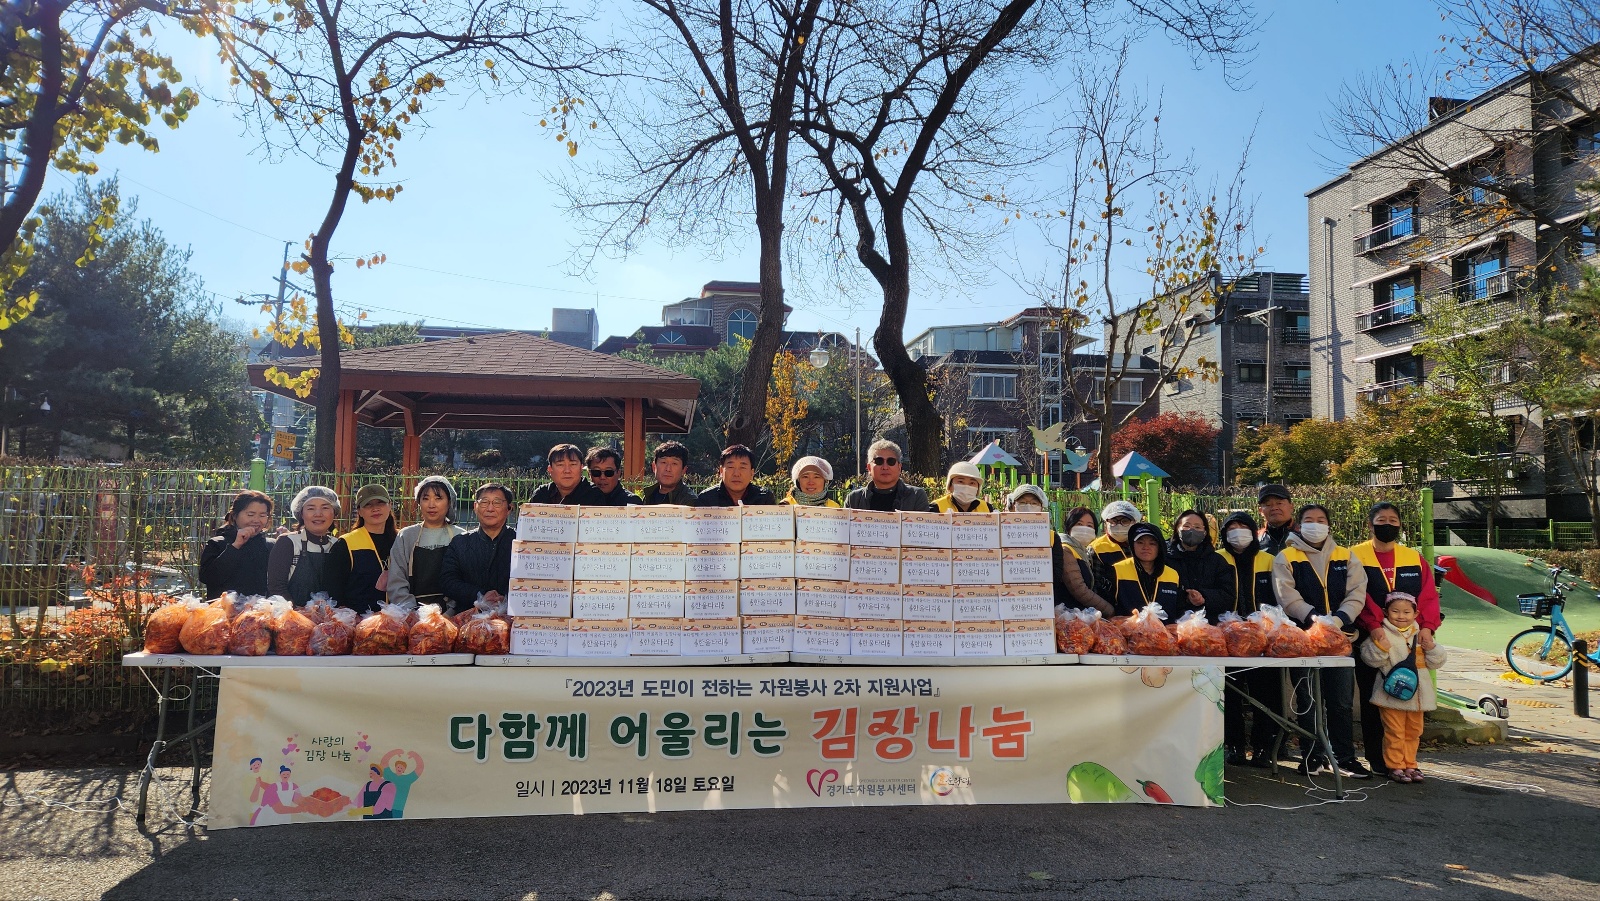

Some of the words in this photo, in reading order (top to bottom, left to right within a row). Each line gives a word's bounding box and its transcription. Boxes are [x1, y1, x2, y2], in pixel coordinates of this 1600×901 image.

[641, 679, 694, 698] 도민이
[701, 679, 753, 697] 전하는
[759, 679, 827, 697] 자원봉사
[834, 679, 861, 696] 2차
[449, 711, 588, 761] 다함께
[608, 710, 788, 758] 어울리는
[811, 705, 1033, 760] 김장나눔
[312, 736, 344, 747] 사랑의
[305, 750, 326, 761] 김장
[331, 750, 351, 761] 나눔
[516, 781, 545, 798] 일시
[561, 779, 611, 795] 2023년
[618, 777, 649, 794] 11월
[656, 776, 687, 793] 18일
[692, 776, 735, 792] 토요일
[826, 784, 916, 797] 경기도자원봉사센터
